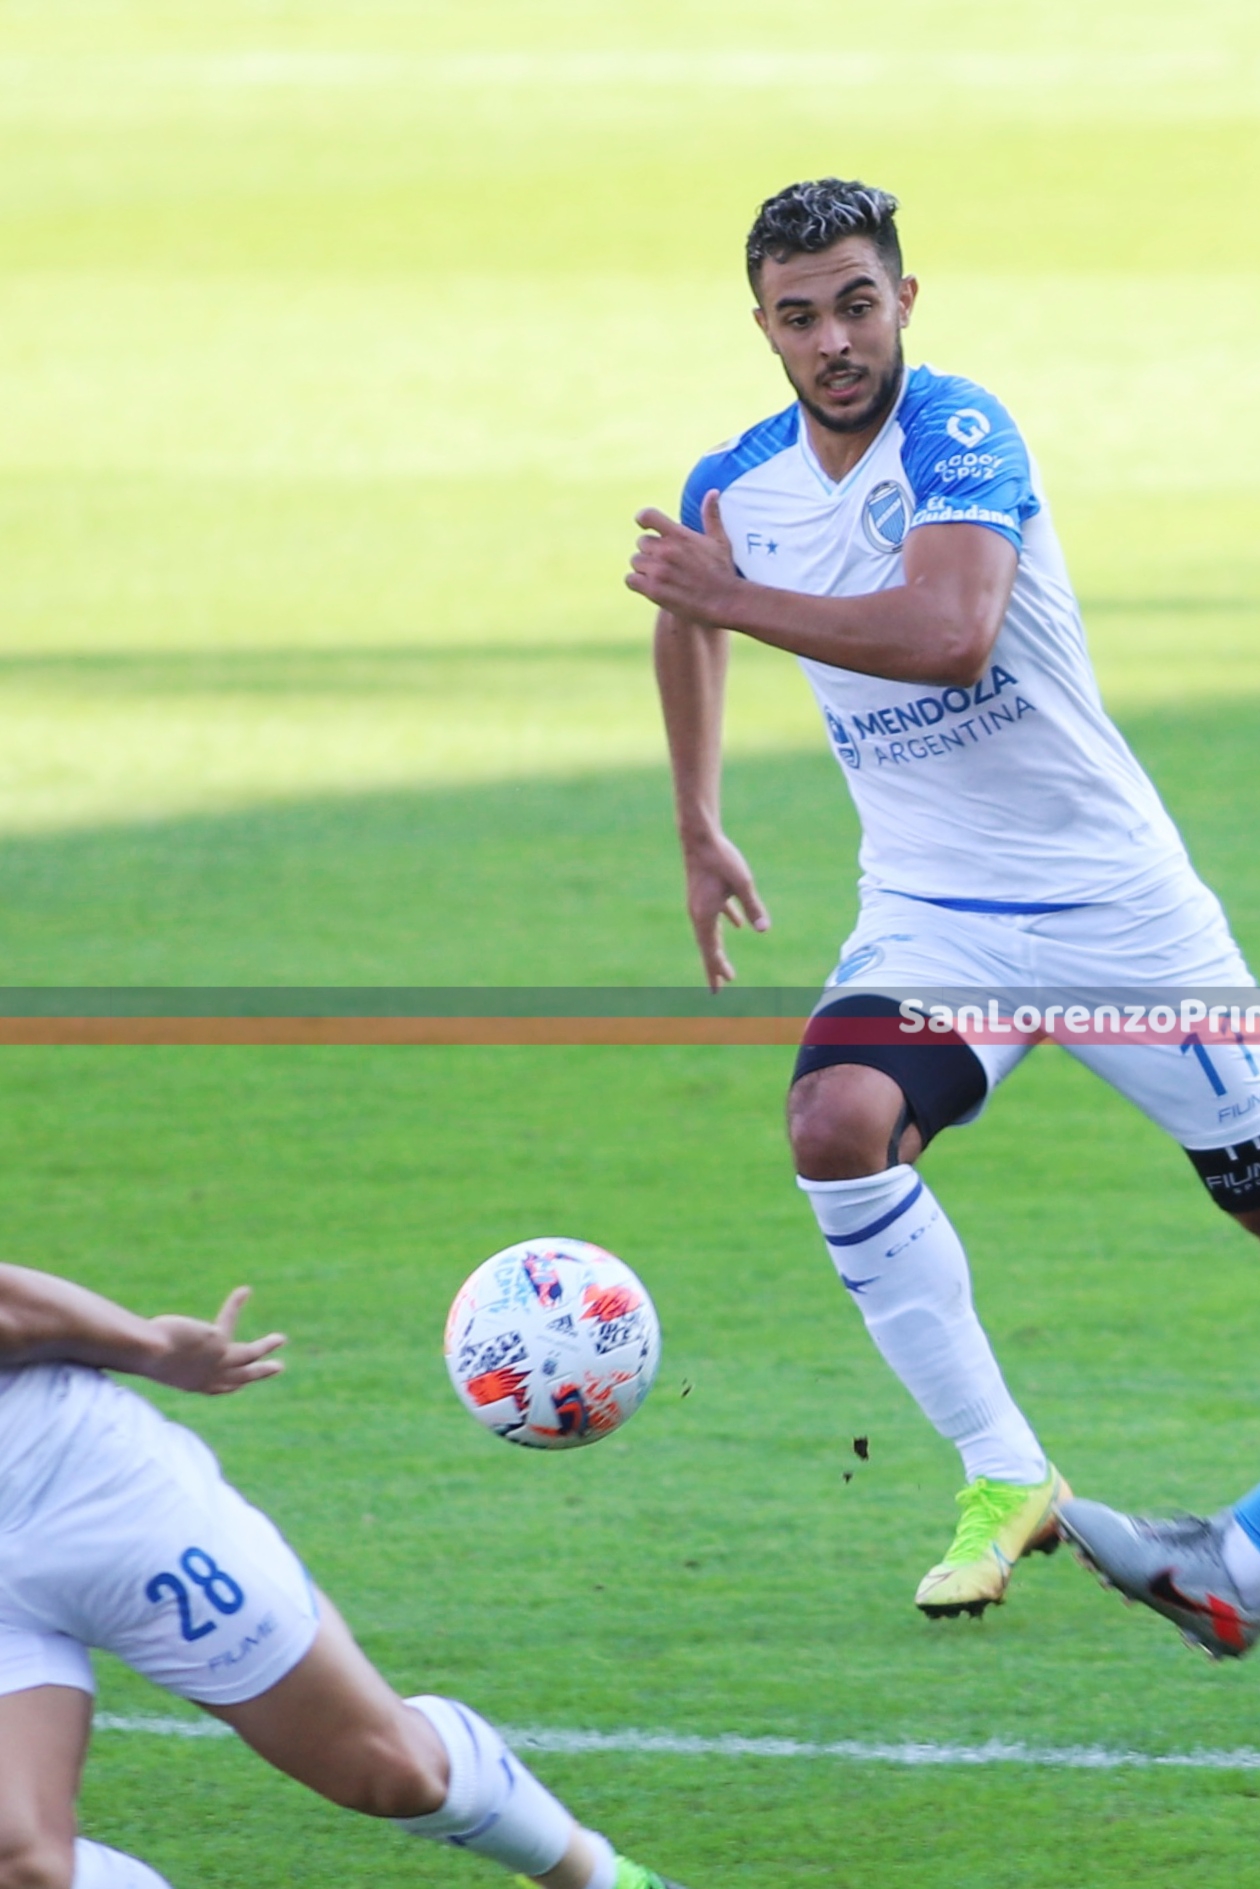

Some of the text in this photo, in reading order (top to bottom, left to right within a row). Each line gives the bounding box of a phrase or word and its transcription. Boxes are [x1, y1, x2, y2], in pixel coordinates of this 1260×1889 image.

[851, 665, 1018, 740] MENDOZA
[873, 695, 1036, 766] ARGENTINA
[146, 1546, 245, 1642] 28
